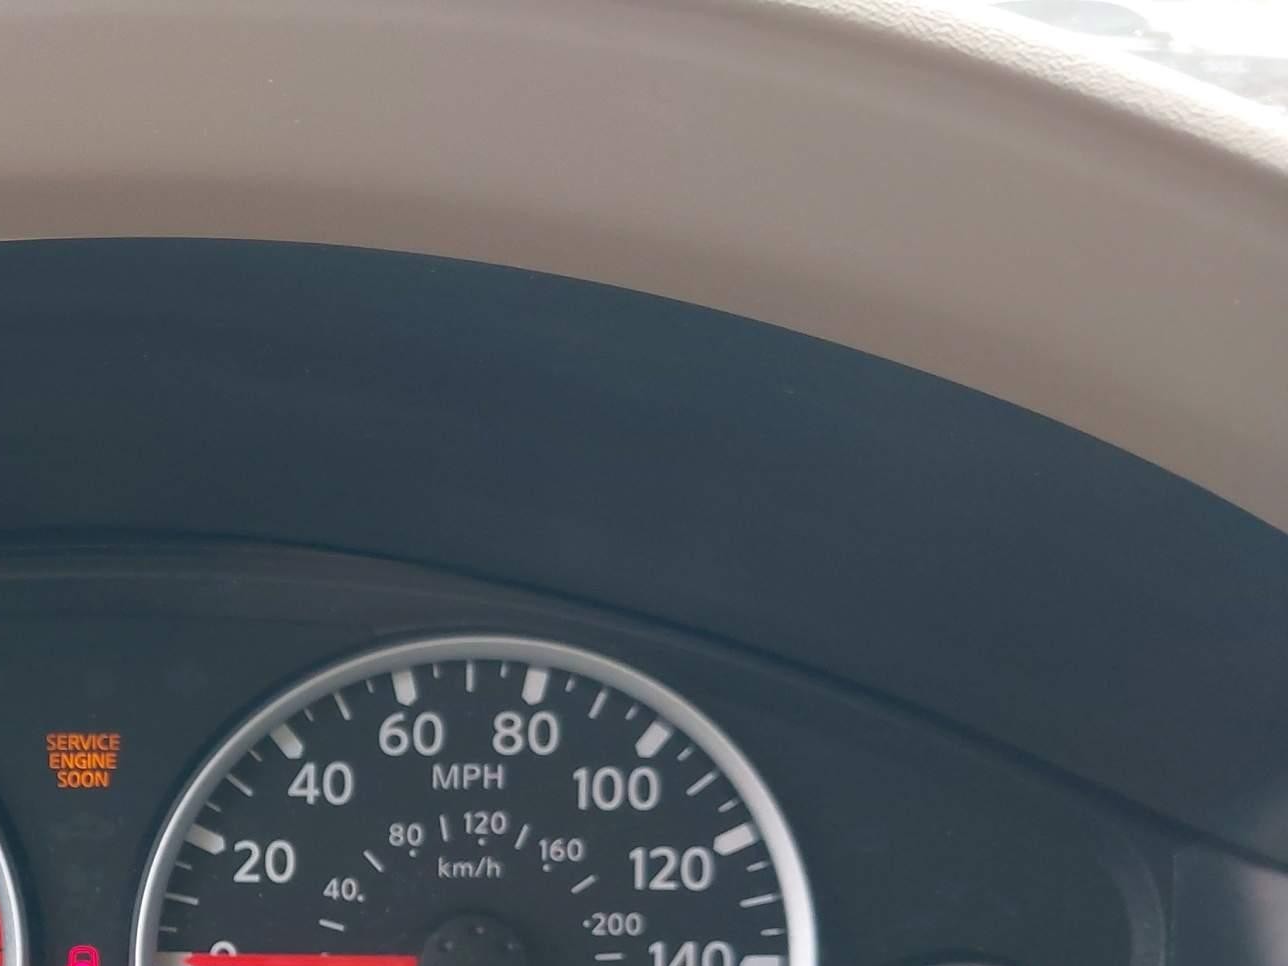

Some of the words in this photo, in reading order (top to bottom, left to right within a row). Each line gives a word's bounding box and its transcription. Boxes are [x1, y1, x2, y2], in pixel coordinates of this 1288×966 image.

[46, 733, 120, 751] SERVICE
[378, 712, 444, 756] 60
[492, 711, 559, 756] 80
[49, 752, 117, 770] ENGINE
[57, 771, 109, 788] SOON
[287, 762, 354, 806] 40
[432, 764, 505, 790] MPH
[573, 767, 660, 811] 100
[388, 823, 424, 847] 80
[463, 811, 508, 835] 120
[233, 840, 295, 883] 20
[539, 838, 584, 862] 160
[438, 856, 502, 879] km/h
[629, 847, 713, 891] 120
[323, 878, 357, 901] 40
[591, 912, 643, 936] 200
